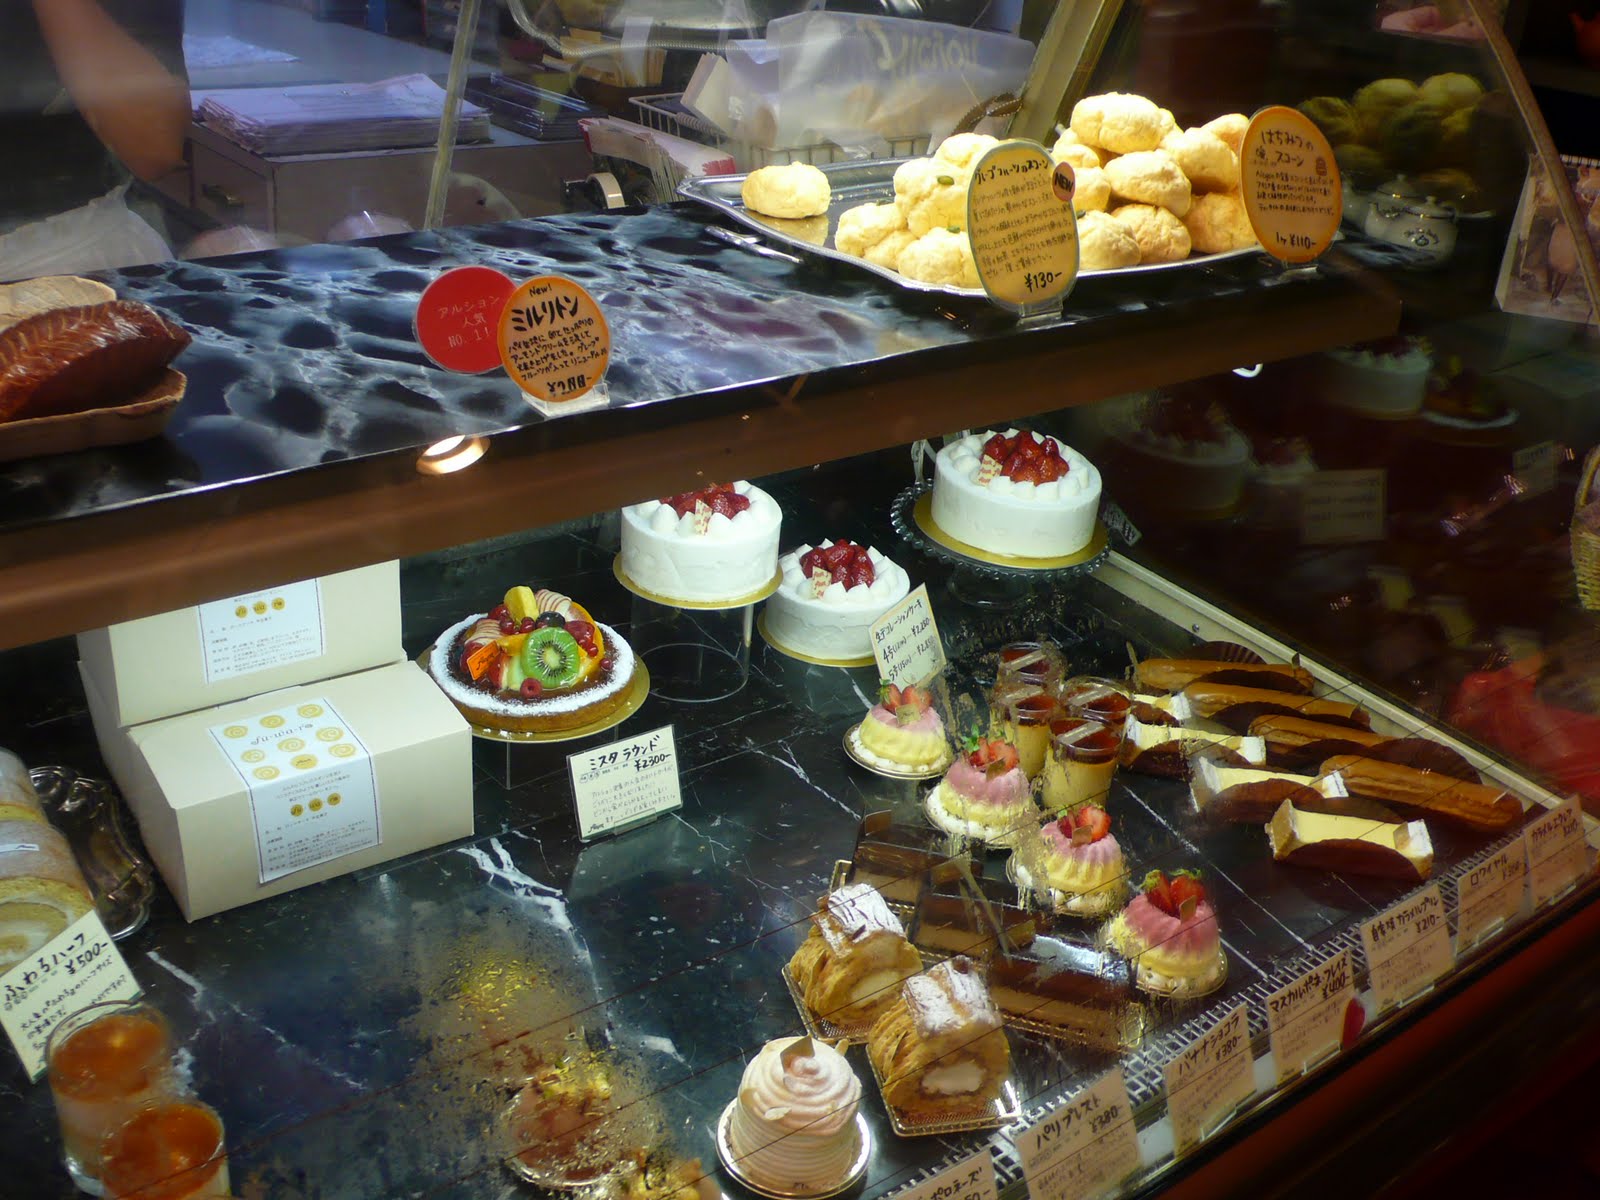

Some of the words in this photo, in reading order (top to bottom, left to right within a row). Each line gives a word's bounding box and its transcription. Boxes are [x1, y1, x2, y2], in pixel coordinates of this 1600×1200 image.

[1054, 172, 1074, 194] NEW
[529, 283, 553, 297] New!
[438, 295, 500, 319] アルション
[511, 295, 579, 332] ミルリトン
[462, 312, 487, 329] 人気
[634, 753, 672, 773] ¥2300-
[64, 942, 109, 975] ¥500-
[1178, 1013, 1240, 1075] バナナショコラ
